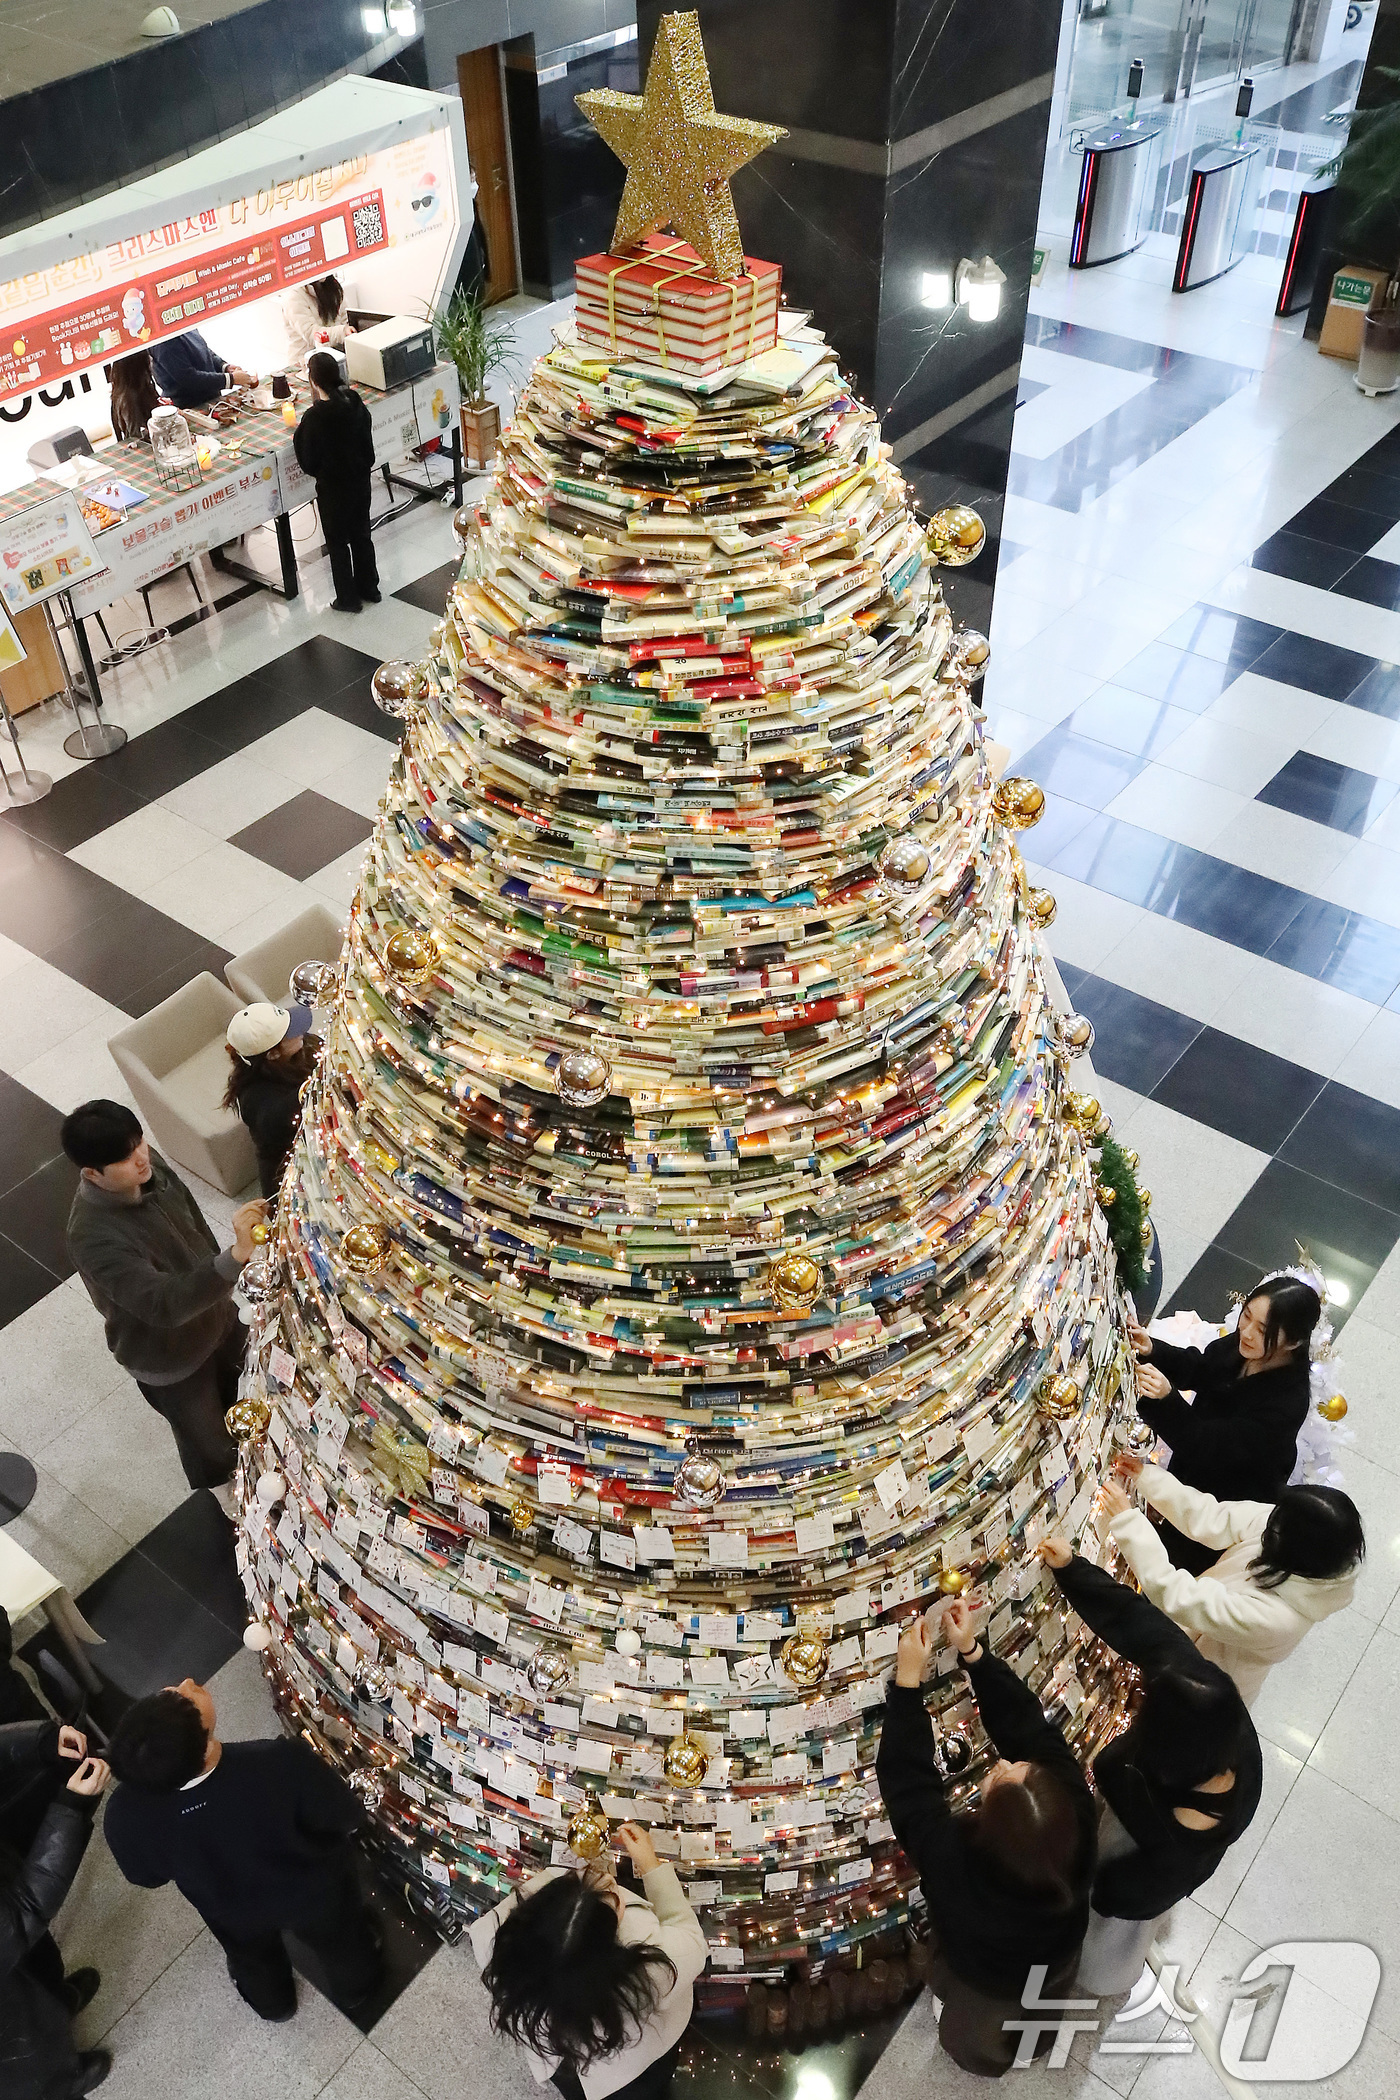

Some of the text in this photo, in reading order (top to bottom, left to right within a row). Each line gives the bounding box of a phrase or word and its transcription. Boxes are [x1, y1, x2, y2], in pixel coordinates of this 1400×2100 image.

[106, 208, 218, 267] 크리스마스엔
[229, 197, 248, 225] 다
[122, 515, 174, 552] 보물구슬
[174, 501, 200, 525] 뽑기
[201, 483, 239, 511] 이벤트
